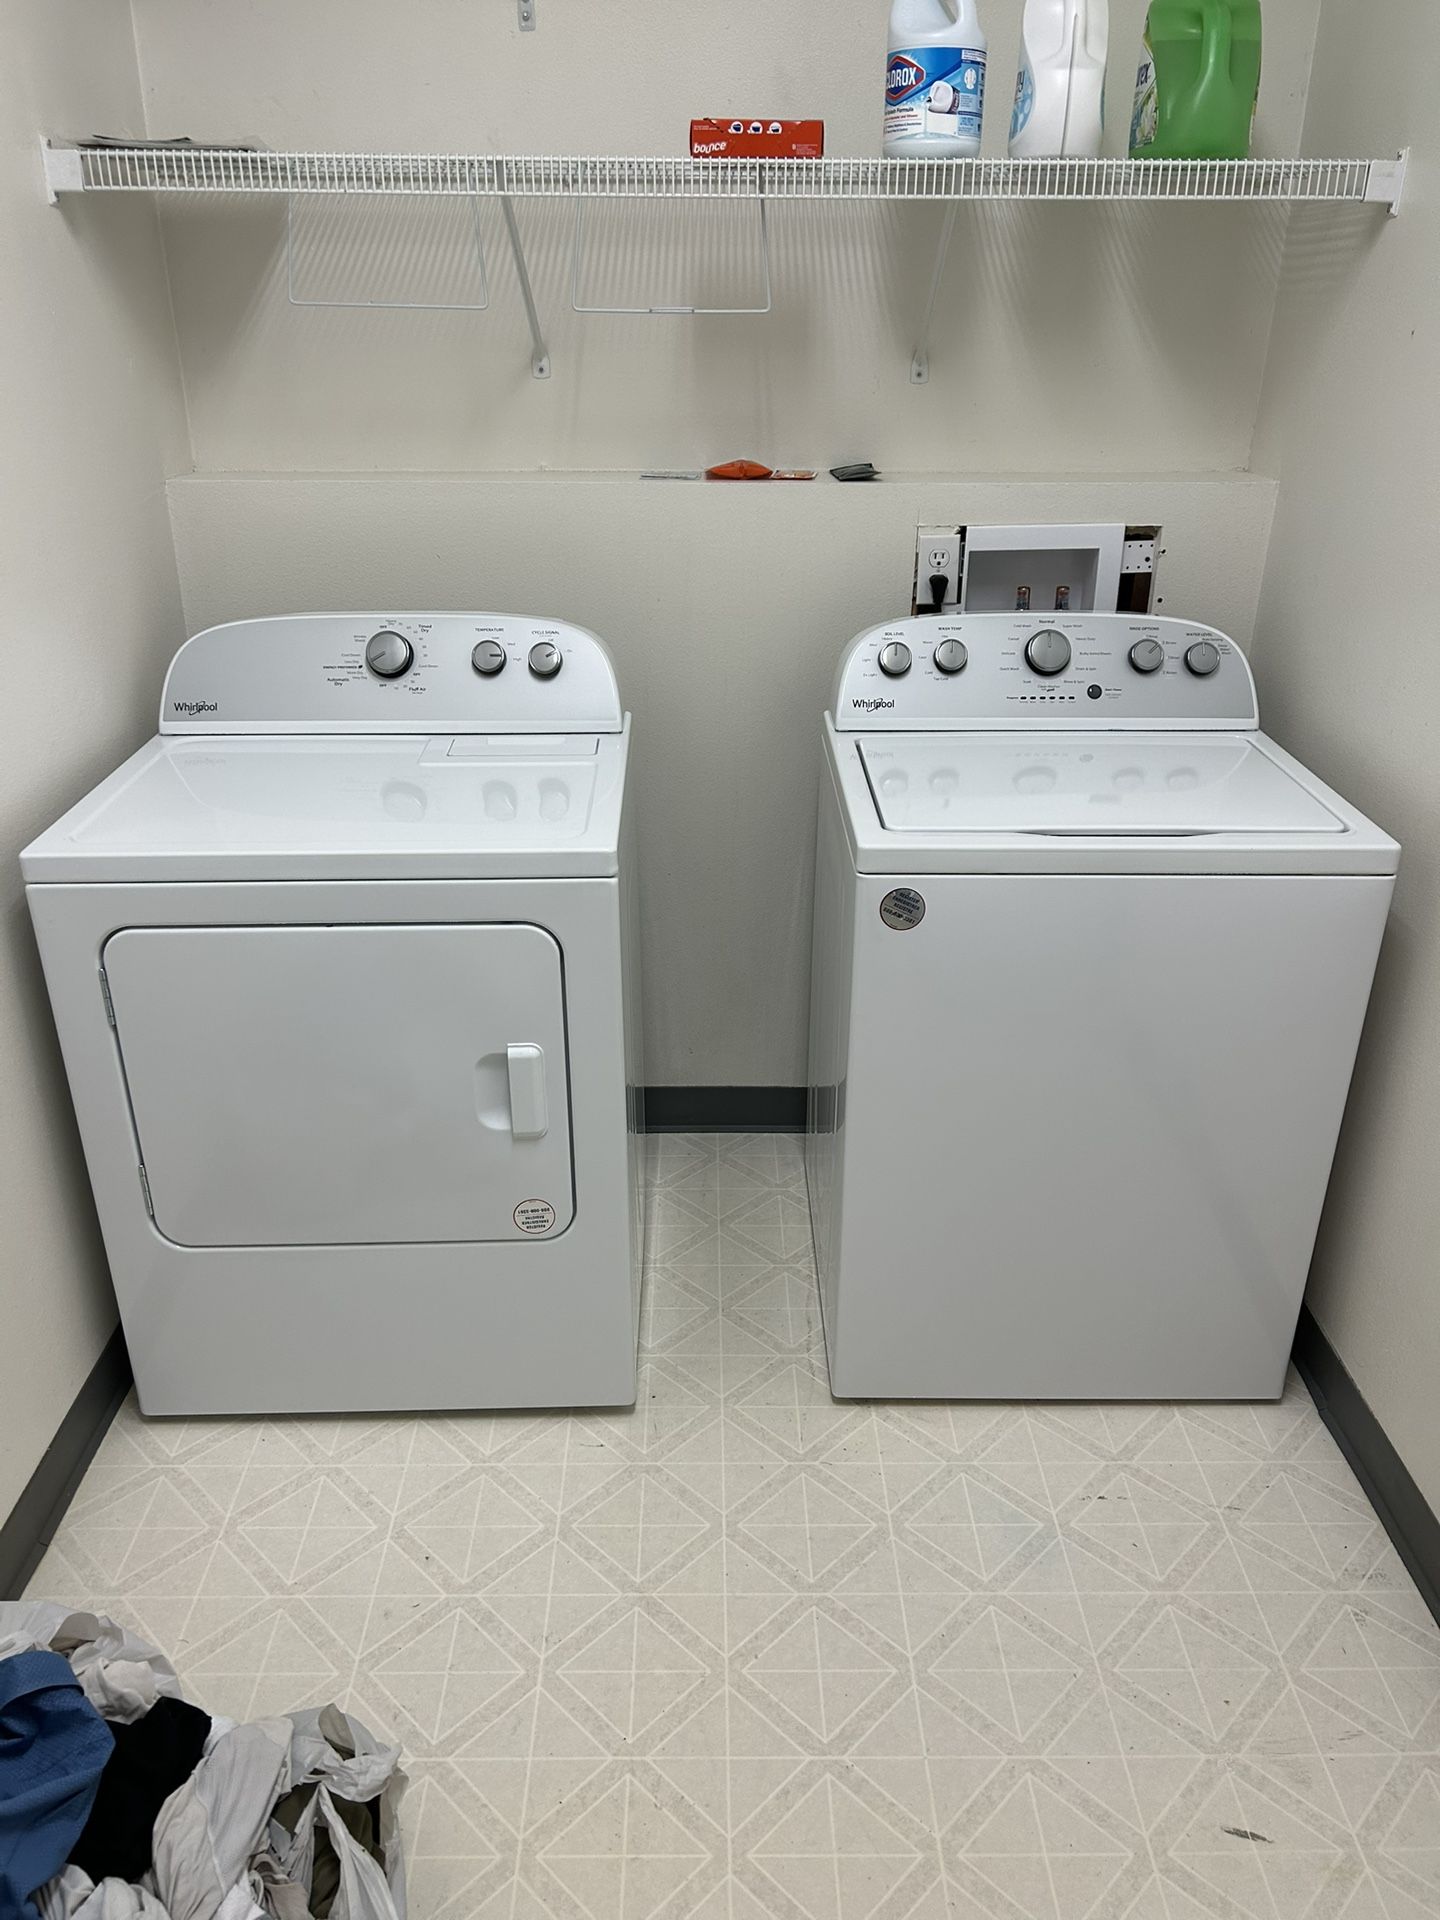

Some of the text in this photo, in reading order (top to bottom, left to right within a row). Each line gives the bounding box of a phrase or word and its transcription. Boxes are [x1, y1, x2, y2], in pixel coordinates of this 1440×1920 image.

[693, 141, 728, 154] bounce
[174, 700, 218, 715] Whirlpool
[852, 698, 895, 712] Whirlpool
